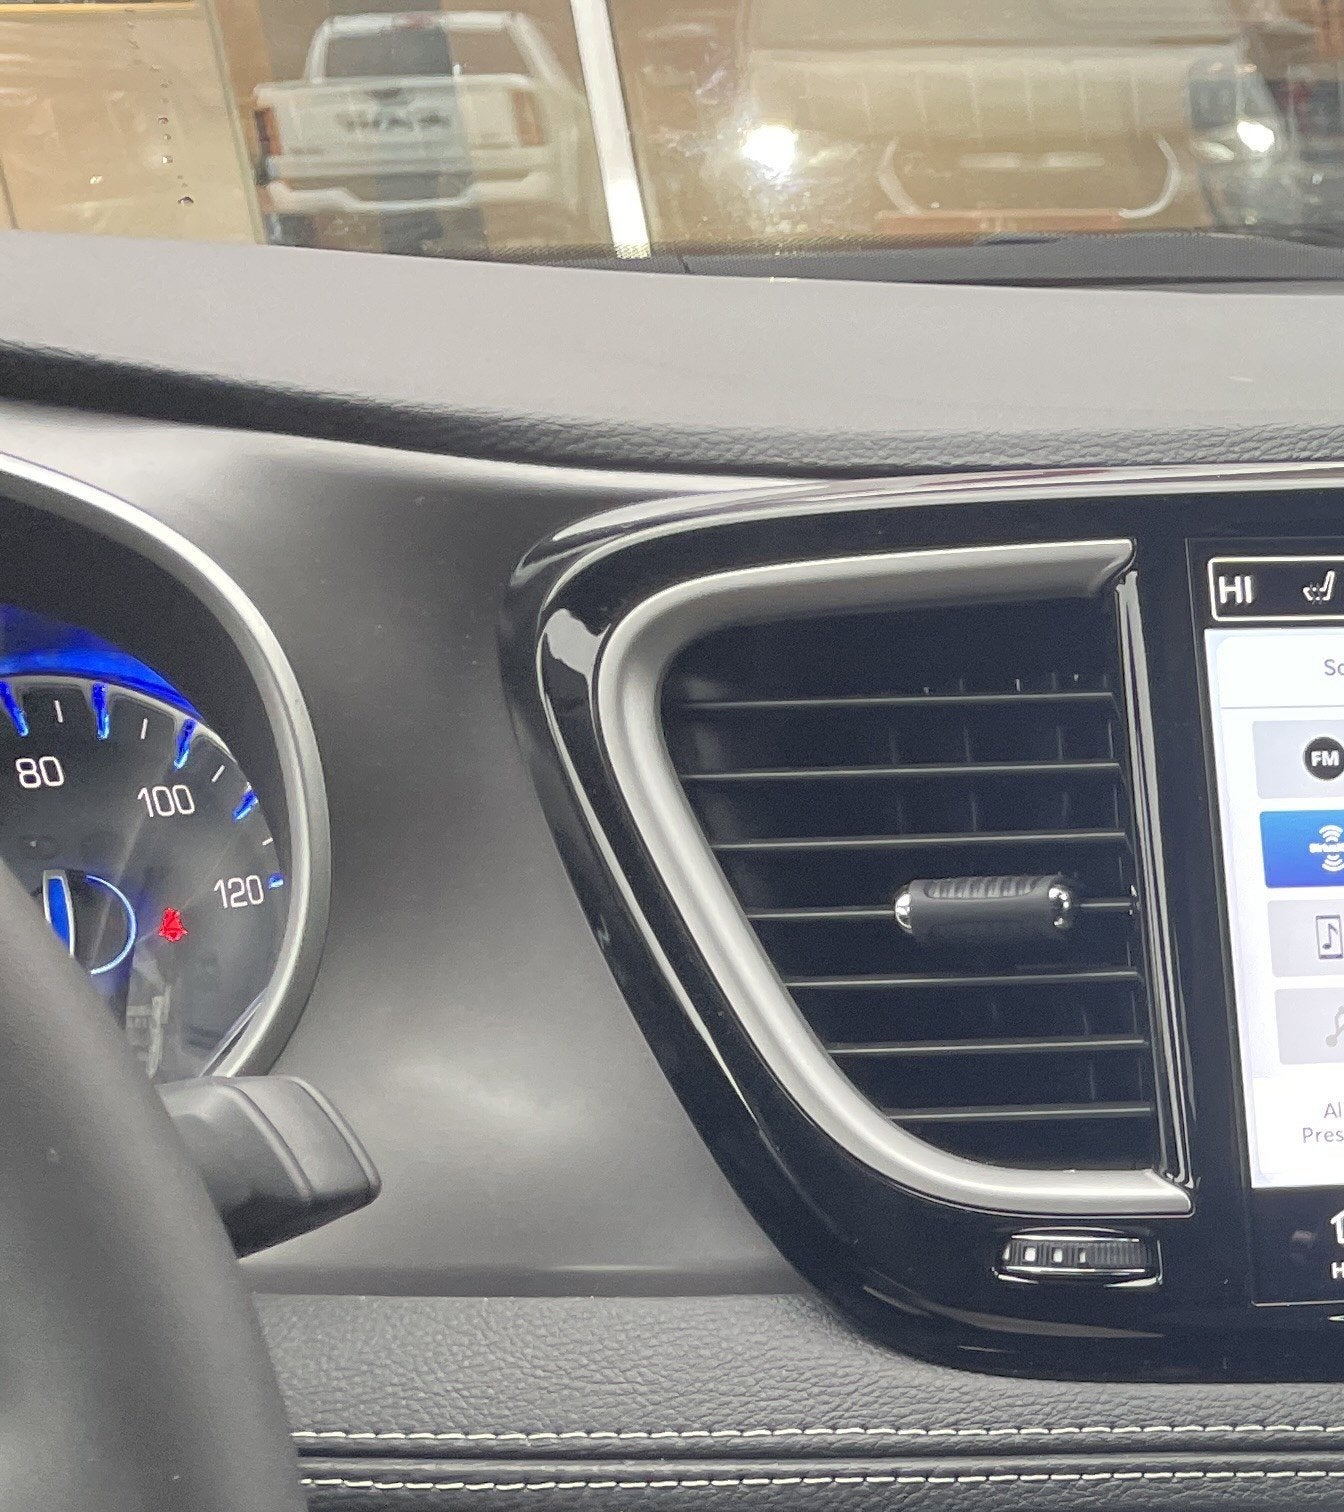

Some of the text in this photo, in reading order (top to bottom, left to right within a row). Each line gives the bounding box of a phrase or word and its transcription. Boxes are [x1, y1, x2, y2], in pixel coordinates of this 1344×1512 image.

[1218, 575, 1253, 604] HI
[15, 755, 65, 789] 80
[1311, 749, 1341, 768] FM
[137, 784, 196, 818] 100
[213, 874, 266, 910] 120
